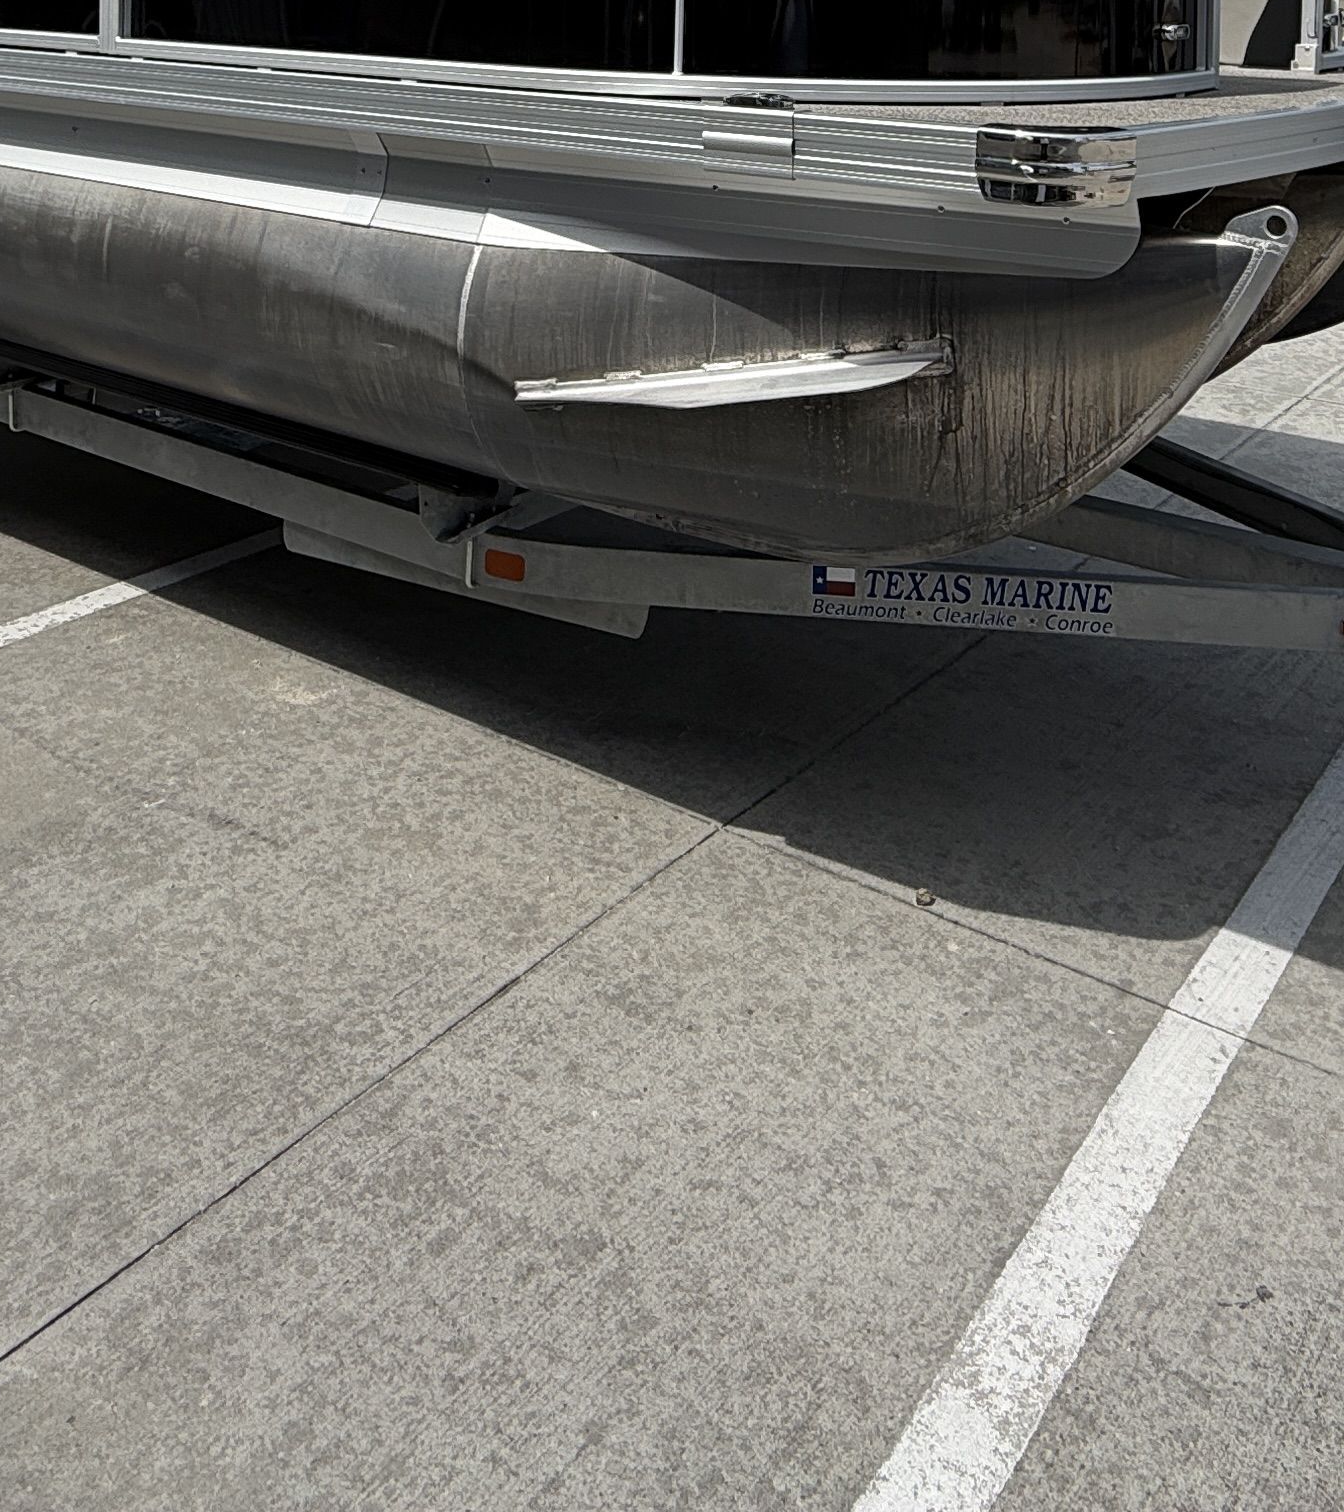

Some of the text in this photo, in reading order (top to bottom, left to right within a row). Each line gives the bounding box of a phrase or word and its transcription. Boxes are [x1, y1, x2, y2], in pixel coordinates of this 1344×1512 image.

[864, 568, 1113, 615] TEXAS MARINE
[812, 598, 1114, 635] Beaumont Clearlake Conroe
